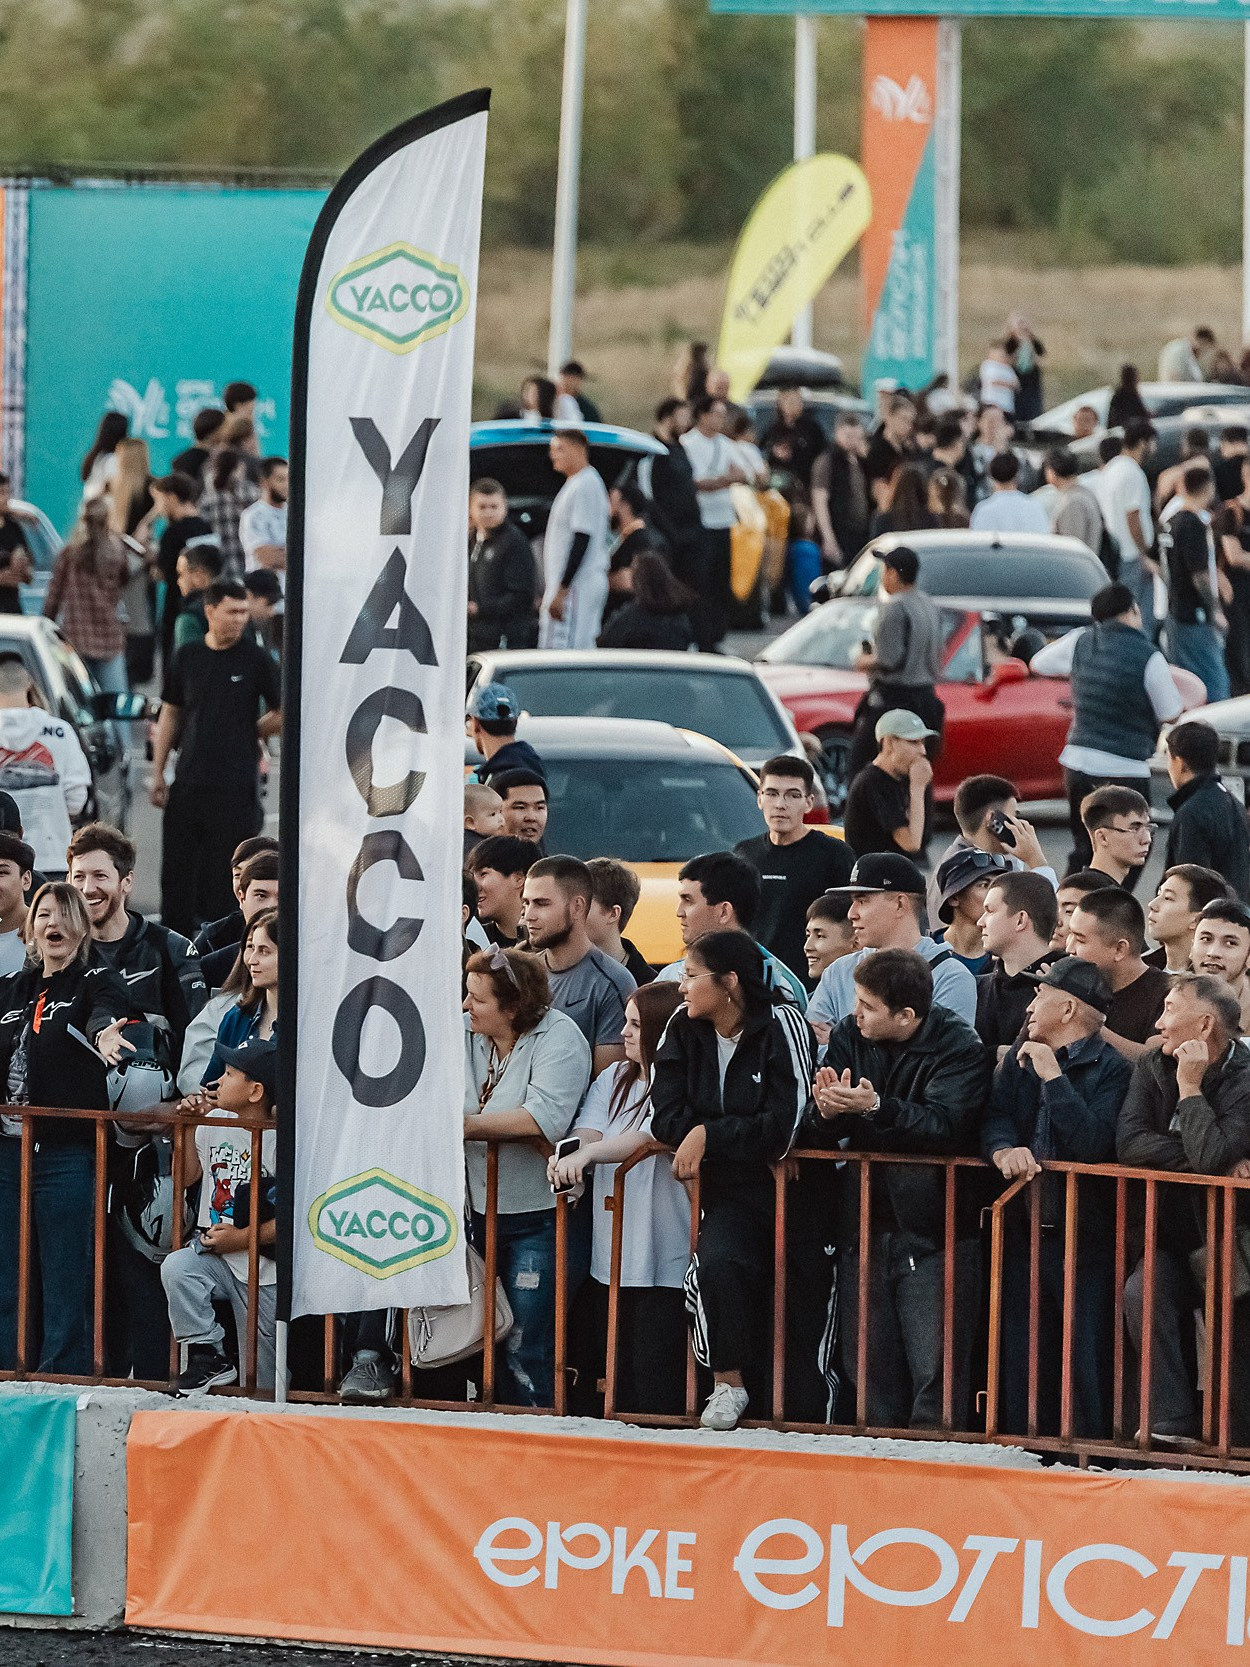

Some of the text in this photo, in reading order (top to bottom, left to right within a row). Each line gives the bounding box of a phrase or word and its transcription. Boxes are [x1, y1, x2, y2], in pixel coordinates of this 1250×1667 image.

[350, 283, 453, 313] YACCO
[332, 416, 442, 1109] YACCO
[326, 1209, 435, 1243] YACCO
[733, 1518, 1250, 1646] ЕРТІСТІ
